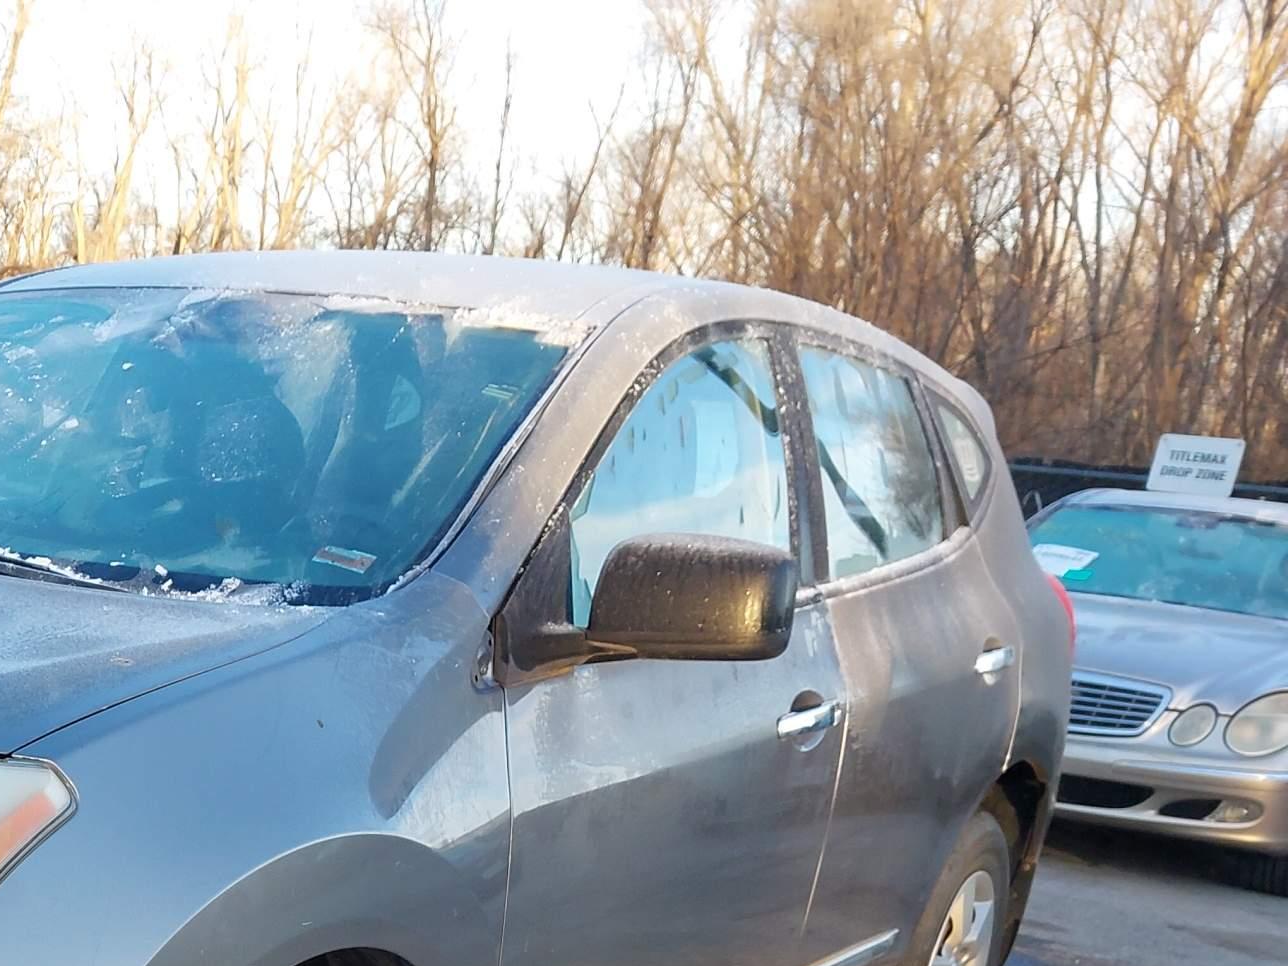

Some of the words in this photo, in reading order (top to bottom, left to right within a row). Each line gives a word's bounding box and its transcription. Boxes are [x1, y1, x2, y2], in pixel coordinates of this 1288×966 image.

[1169, 450, 1228, 463] TITLEMAX
[1160, 465, 1192, 477] DROP
[1195, 468, 1227, 480] ZONE
